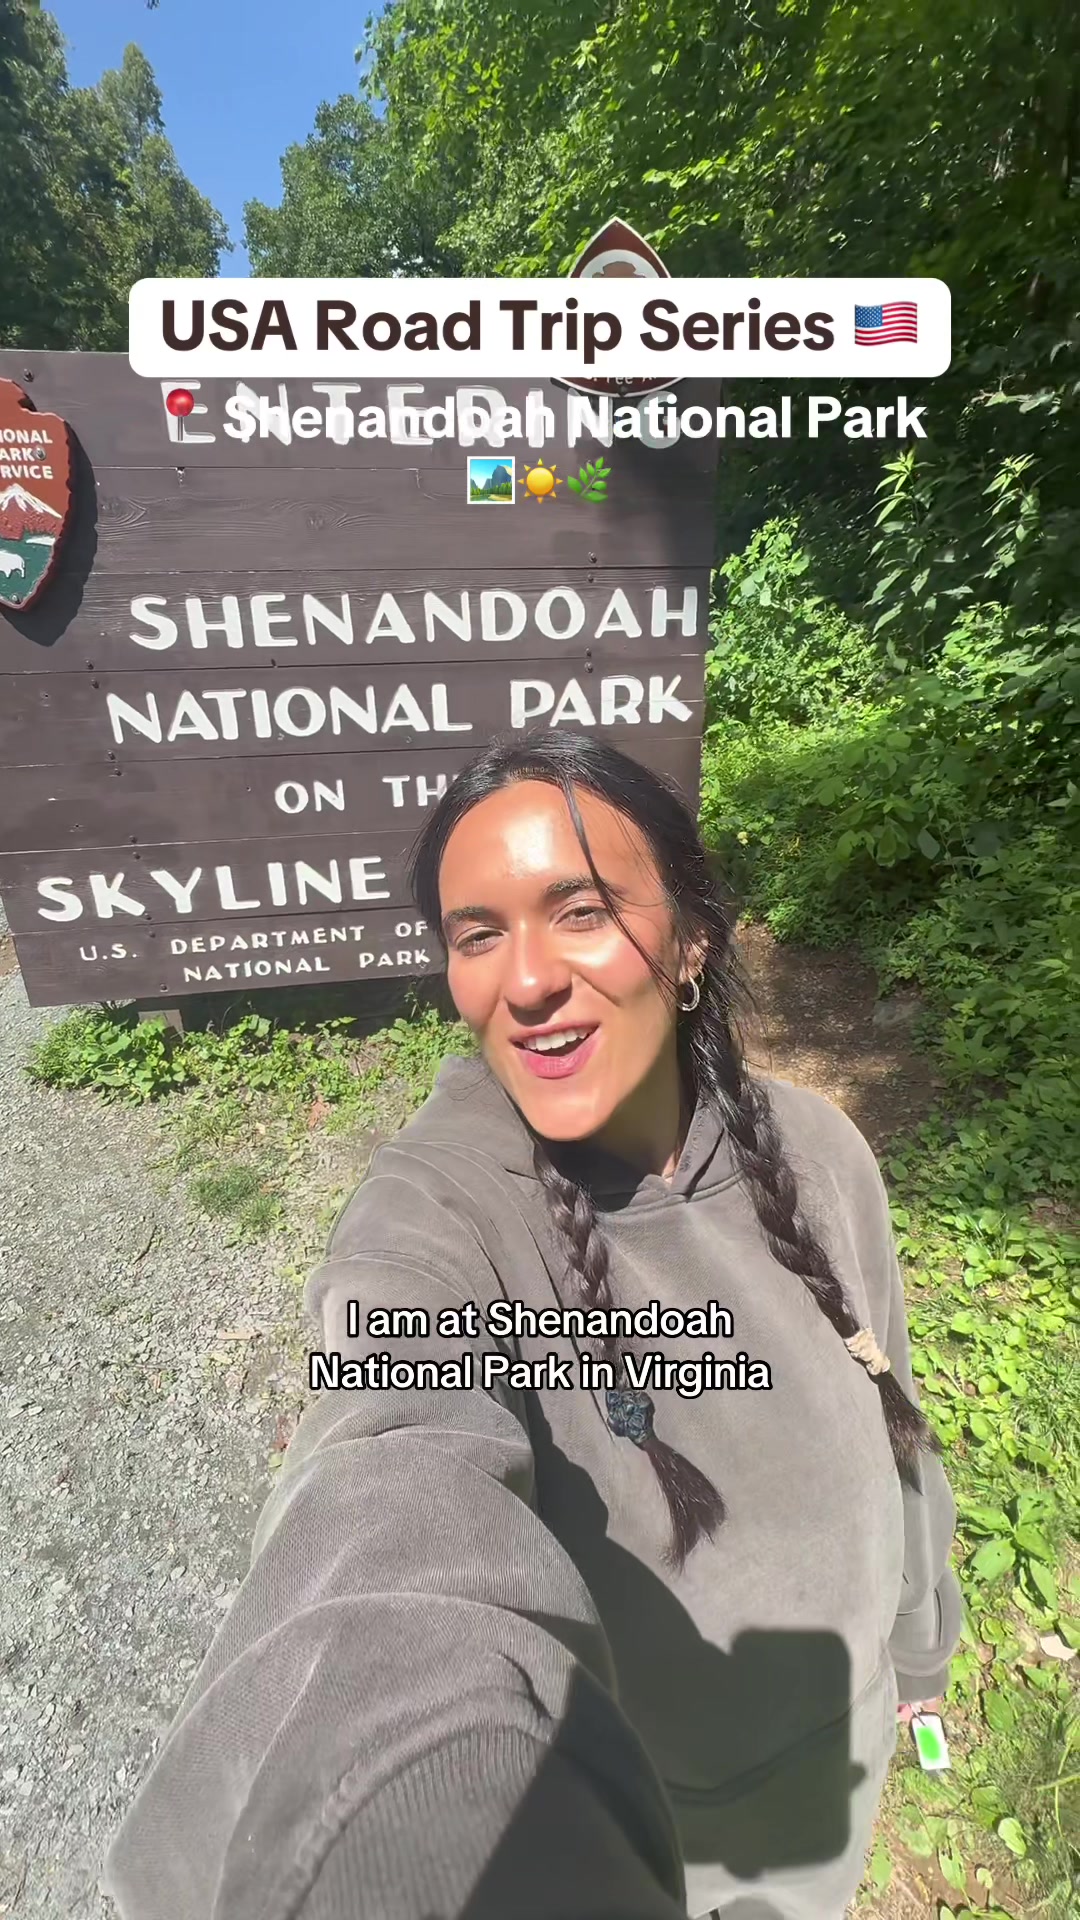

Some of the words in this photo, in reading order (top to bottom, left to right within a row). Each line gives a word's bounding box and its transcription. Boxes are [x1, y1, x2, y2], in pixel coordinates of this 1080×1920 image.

[129, 586, 699, 651] SHENANDOAH
[106, 683, 473, 744] NATIONAL
[510, 675, 693, 729] PARK
[274, 780, 345, 814] ON
[382, 773, 459, 807] TH
[37, 856, 391, 922] SKYLINE
[80, 943, 138, 962] U.S.
[170, 925, 365, 955] DEPARTMENT
[394, 920, 428, 938] OF
[184, 956, 330, 983] NATIONAL
[359, 948, 431, 968] PARK
